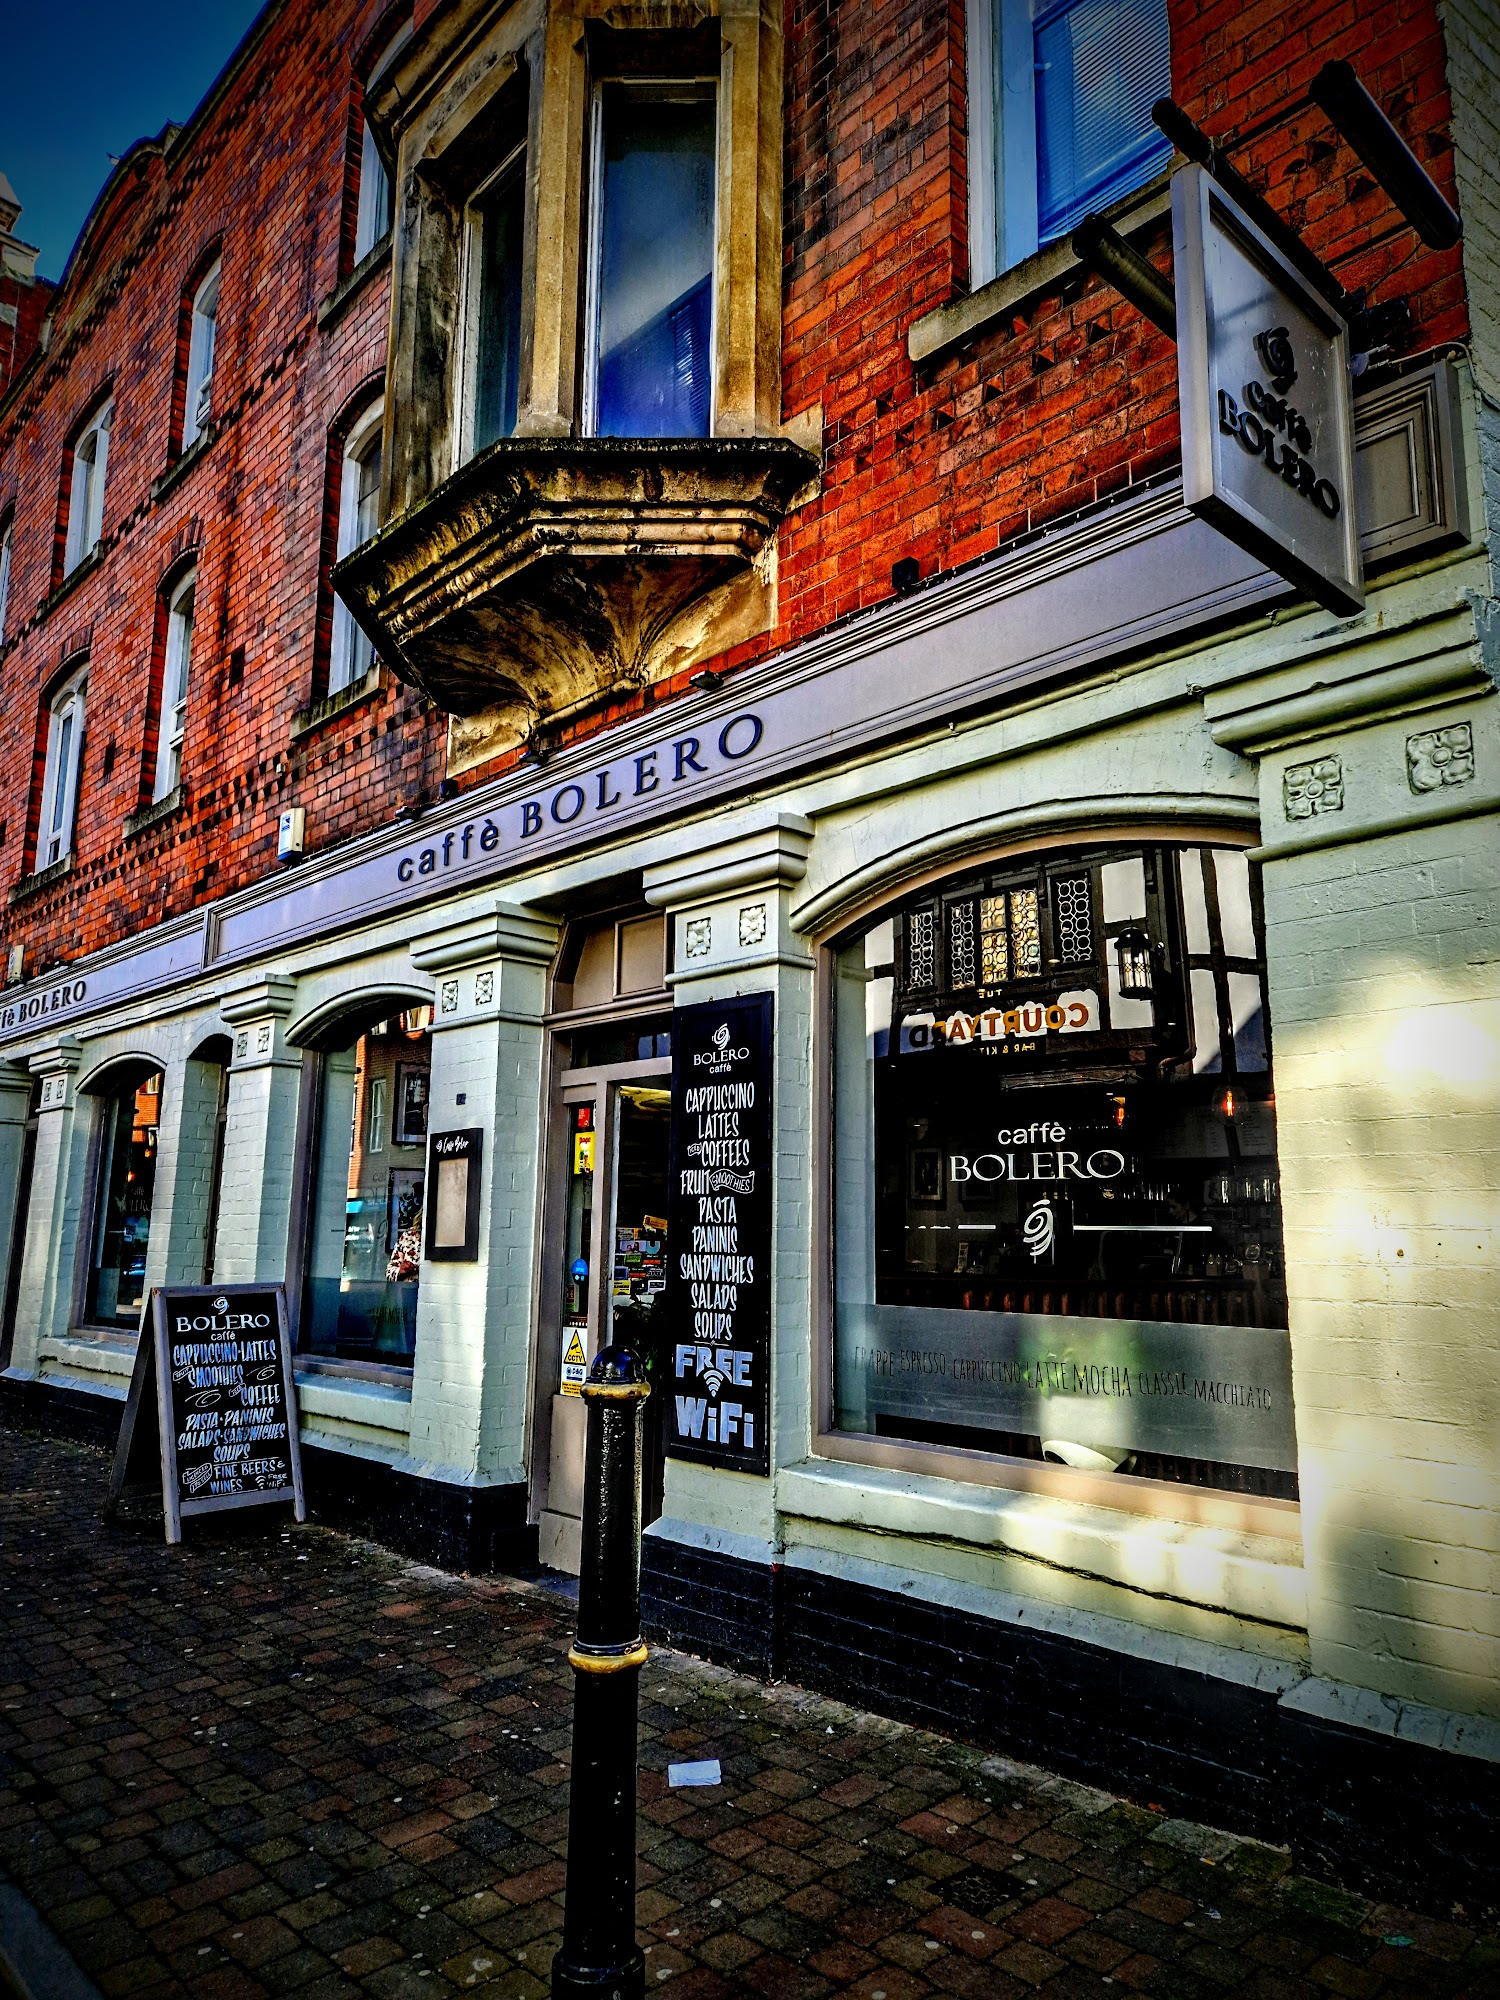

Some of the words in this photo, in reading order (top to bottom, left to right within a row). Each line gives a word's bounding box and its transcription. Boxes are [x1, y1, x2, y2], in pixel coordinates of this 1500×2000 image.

[1217, 388, 1341, 519] BOLERO
[396, 818, 500, 882] caffè
[519, 713, 764, 839] BOLERO
[18, 980, 87, 1023] BOLERO
[693, 1047, 750, 1066] BOLERO
[709, 1062, 732, 1075] caffè
[685, 1082, 755, 1114] CAPPUCCINO
[698, 1111, 740, 1140] LATTES
[997, 1121, 1066, 1145] caffè
[701, 1139, 750, 1167] COFFEES
[949, 1149, 1125, 1181] BOLERO
[680, 1169, 710, 1195] FRUIT
[711, 1172, 751, 1191] SMOOTHIES
[698, 1196, 738, 1224] PASTA
[691, 1225, 738, 1254] PANINIS
[680, 1253, 754, 1284] SANDWICHES
[690, 1282, 738, 1312] SALADS
[175, 1313, 270, 1333] BOLERO
[210, 1330, 236, 1341] caffè
[694, 1311, 733, 1341] SOUPS
[172, 1341, 238, 1367] CAPPUCCINO
[240, 1339, 277, 1362] LATTES
[567, 1354, 583, 1363] CCTV
[675, 1343, 754, 1387] FREE
[187, 1364, 244, 1389] SMOOTHIES
[900, 1349, 946, 1376] ESPRESSO
[952, 1358, 1021, 1384] CAPPUCCINO
[1026, 1360, 1068, 1390] LATTE
[1073, 1363, 1132, 1398] MOCHA
[1138, 1371, 1190, 1396] CLASSIC
[1193, 1378, 1271, 1411] MACCHIATO
[240, 1383, 281, 1407] COFFEE
[185, 1411, 219, 1432] PASTA
[223, 1407, 275, 1427] PANINIS
[675, 1395, 754, 1448] WiFi
[177, 1428, 221, 1451] SALADS
[223, 1422, 286, 1444] SANDWICHES
[213, 1443, 251, 1463] SOUPS
[213, 1464, 239, 1480] FINE
[241, 1459, 276, 1476] BEERS
[210, 1478, 244, 1494] WINES
